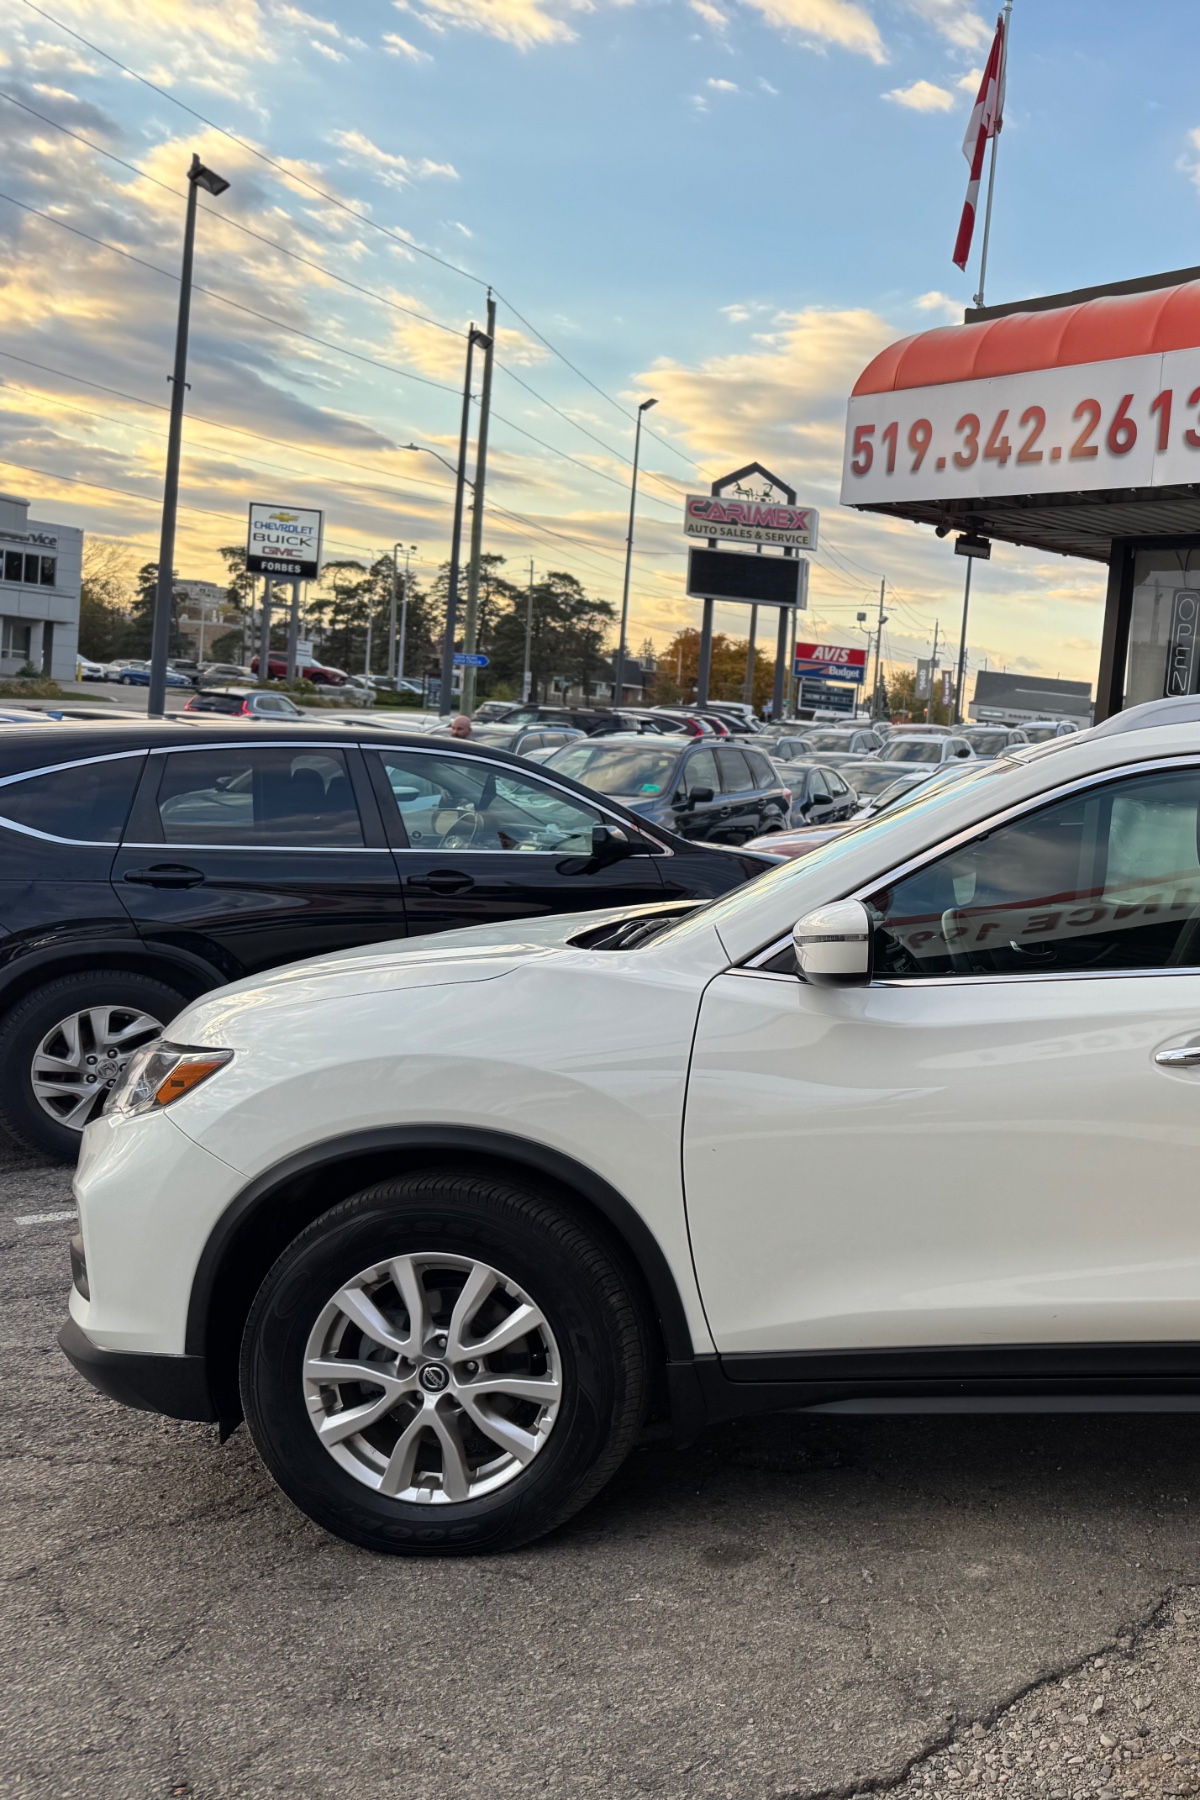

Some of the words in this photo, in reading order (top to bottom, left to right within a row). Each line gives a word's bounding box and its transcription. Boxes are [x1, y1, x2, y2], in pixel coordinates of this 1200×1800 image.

[688, 500, 810, 530] CARIMEX
[254, 521, 314, 535] CHEVROLET
[688, 524, 717, 535] AUTO
[720, 527, 752, 538] SALES
[754, 530, 763, 540] &
[765, 532, 809, 545] SERVICE
[253, 533, 313, 547] BUICK
[262, 546, 303, 558] GMC
[261, 561, 301, 573] FORBES
[1171, 598, 1196, 692] OPEN
[811, 646, 850, 663] AVIS
[829, 666, 860, 679] Budget
